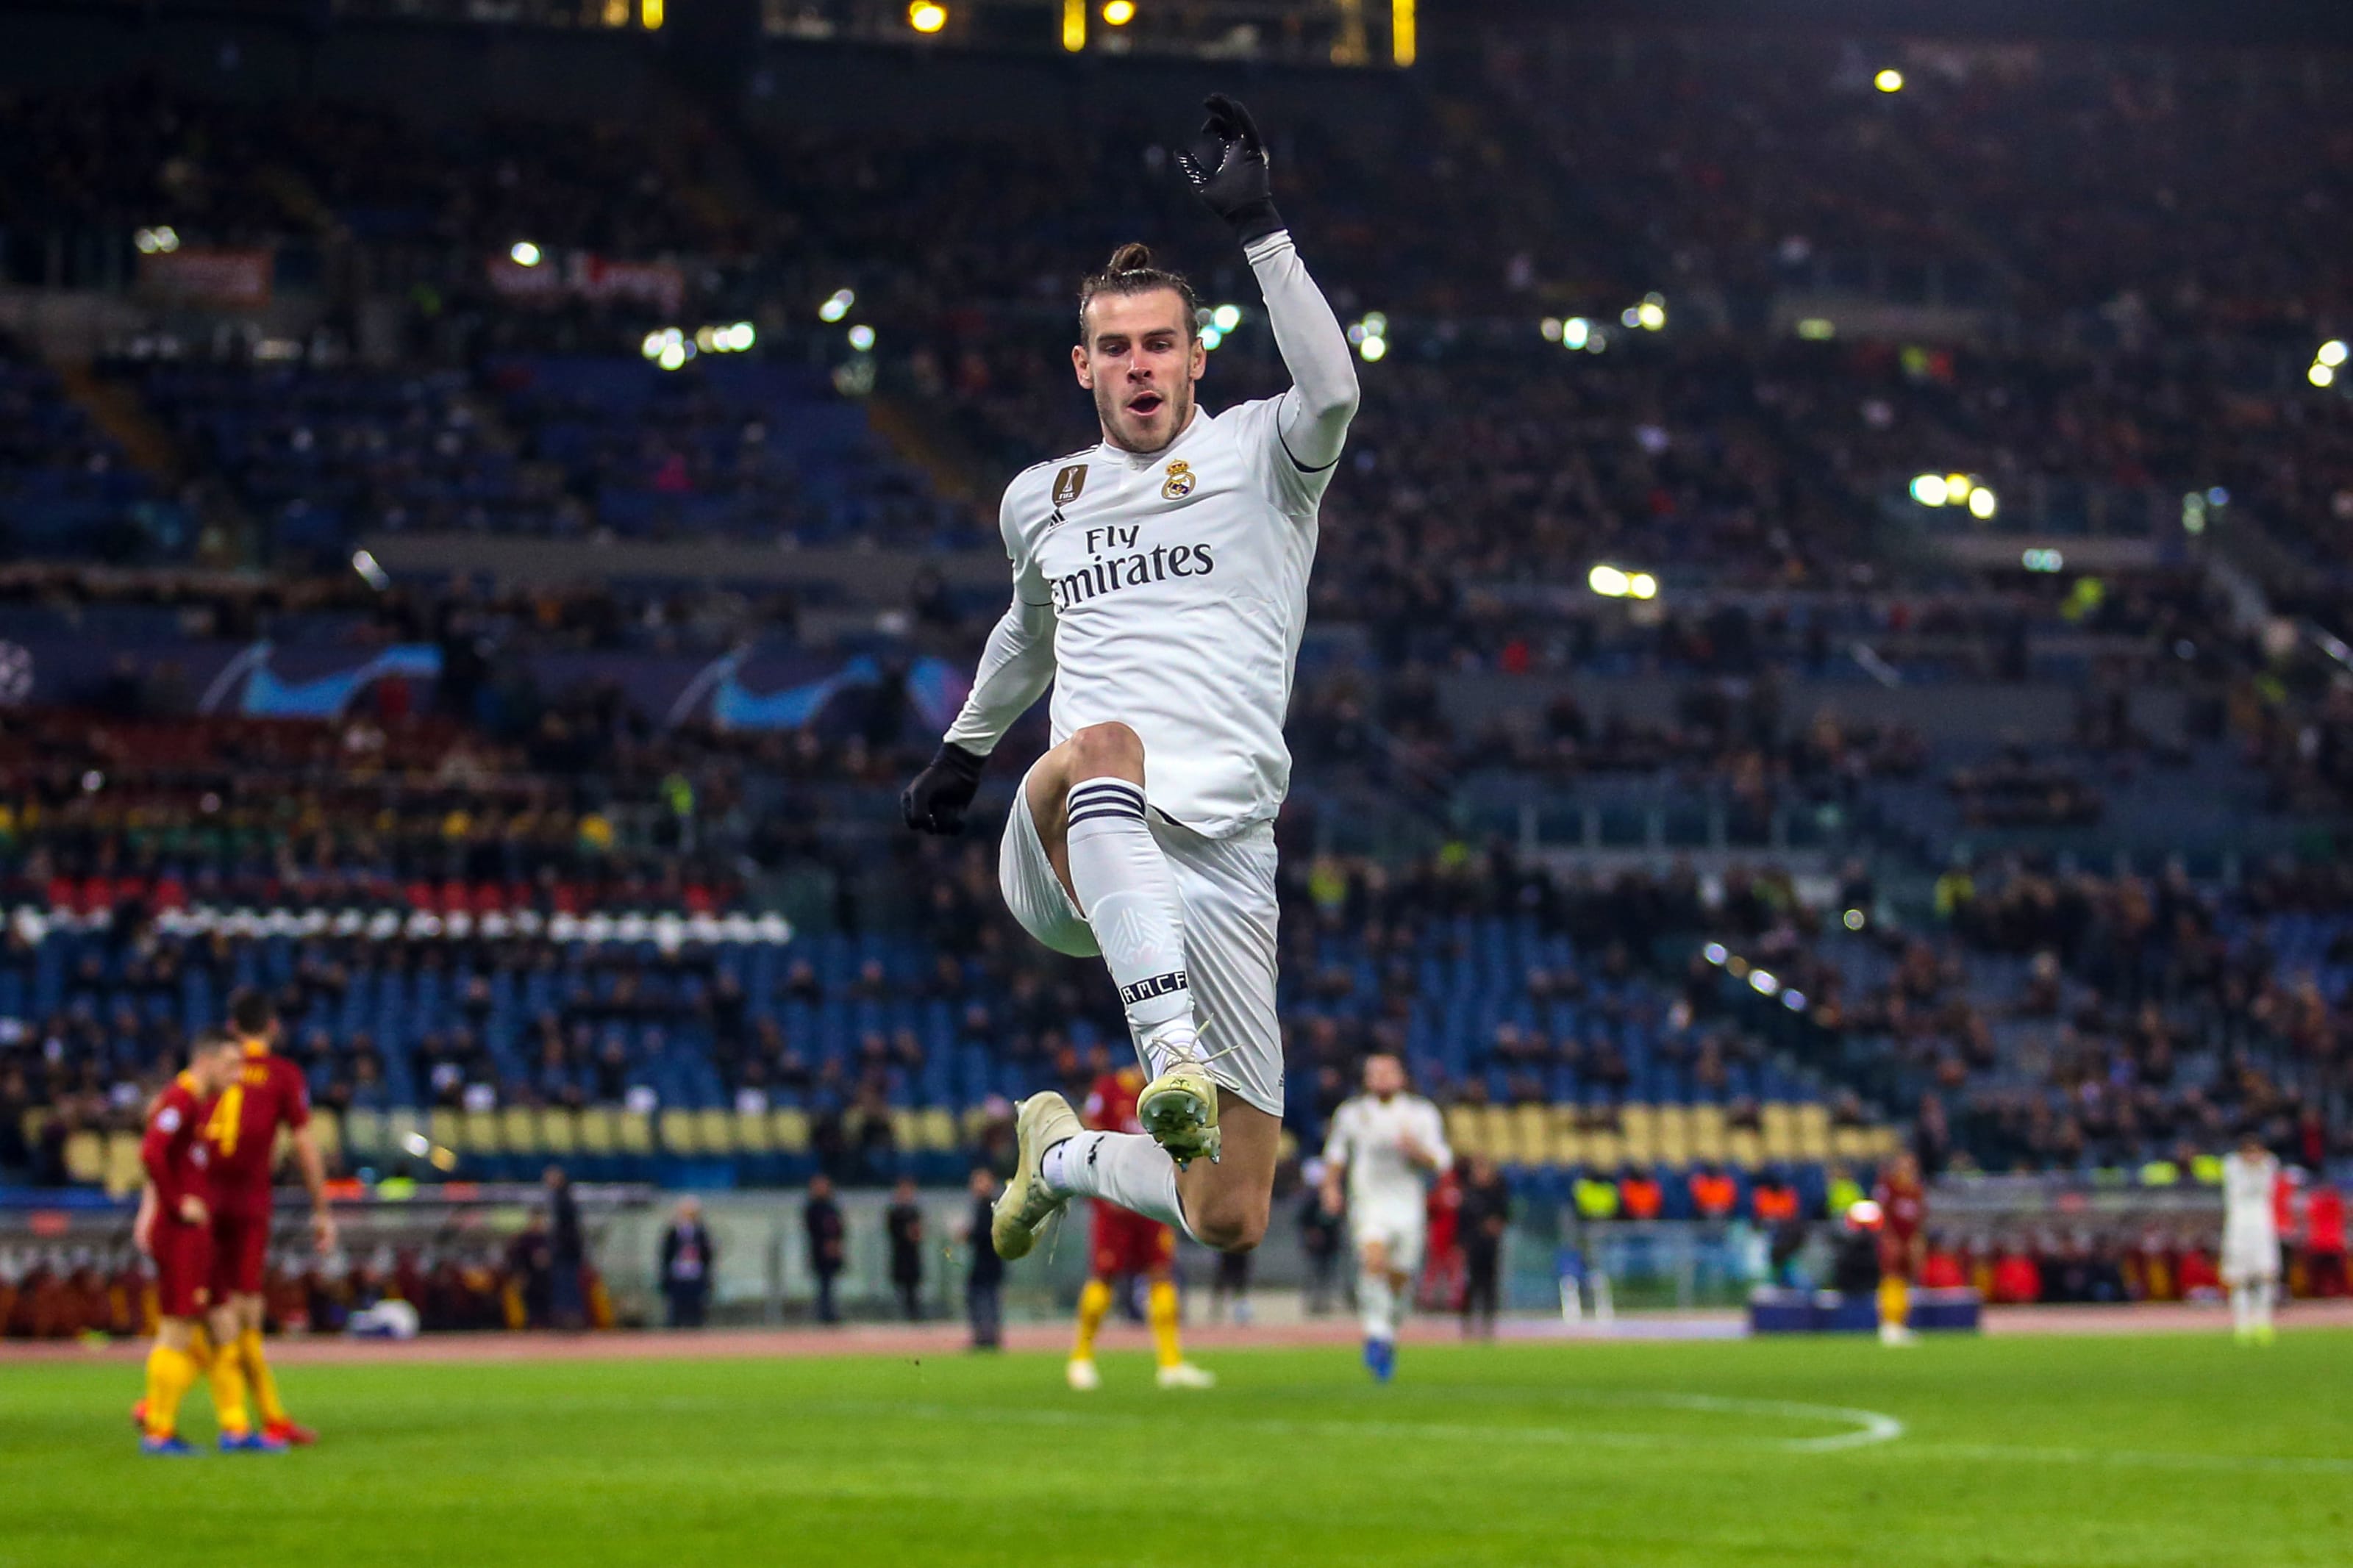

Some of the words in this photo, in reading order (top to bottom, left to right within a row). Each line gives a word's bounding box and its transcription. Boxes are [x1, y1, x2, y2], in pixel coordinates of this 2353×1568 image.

[1085, 525, 1140, 554] Fly
[1051, 543, 1214, 614] mirates
[1122, 973, 1185, 1003] RMCF
[204, 1083, 244, 1158] 4
